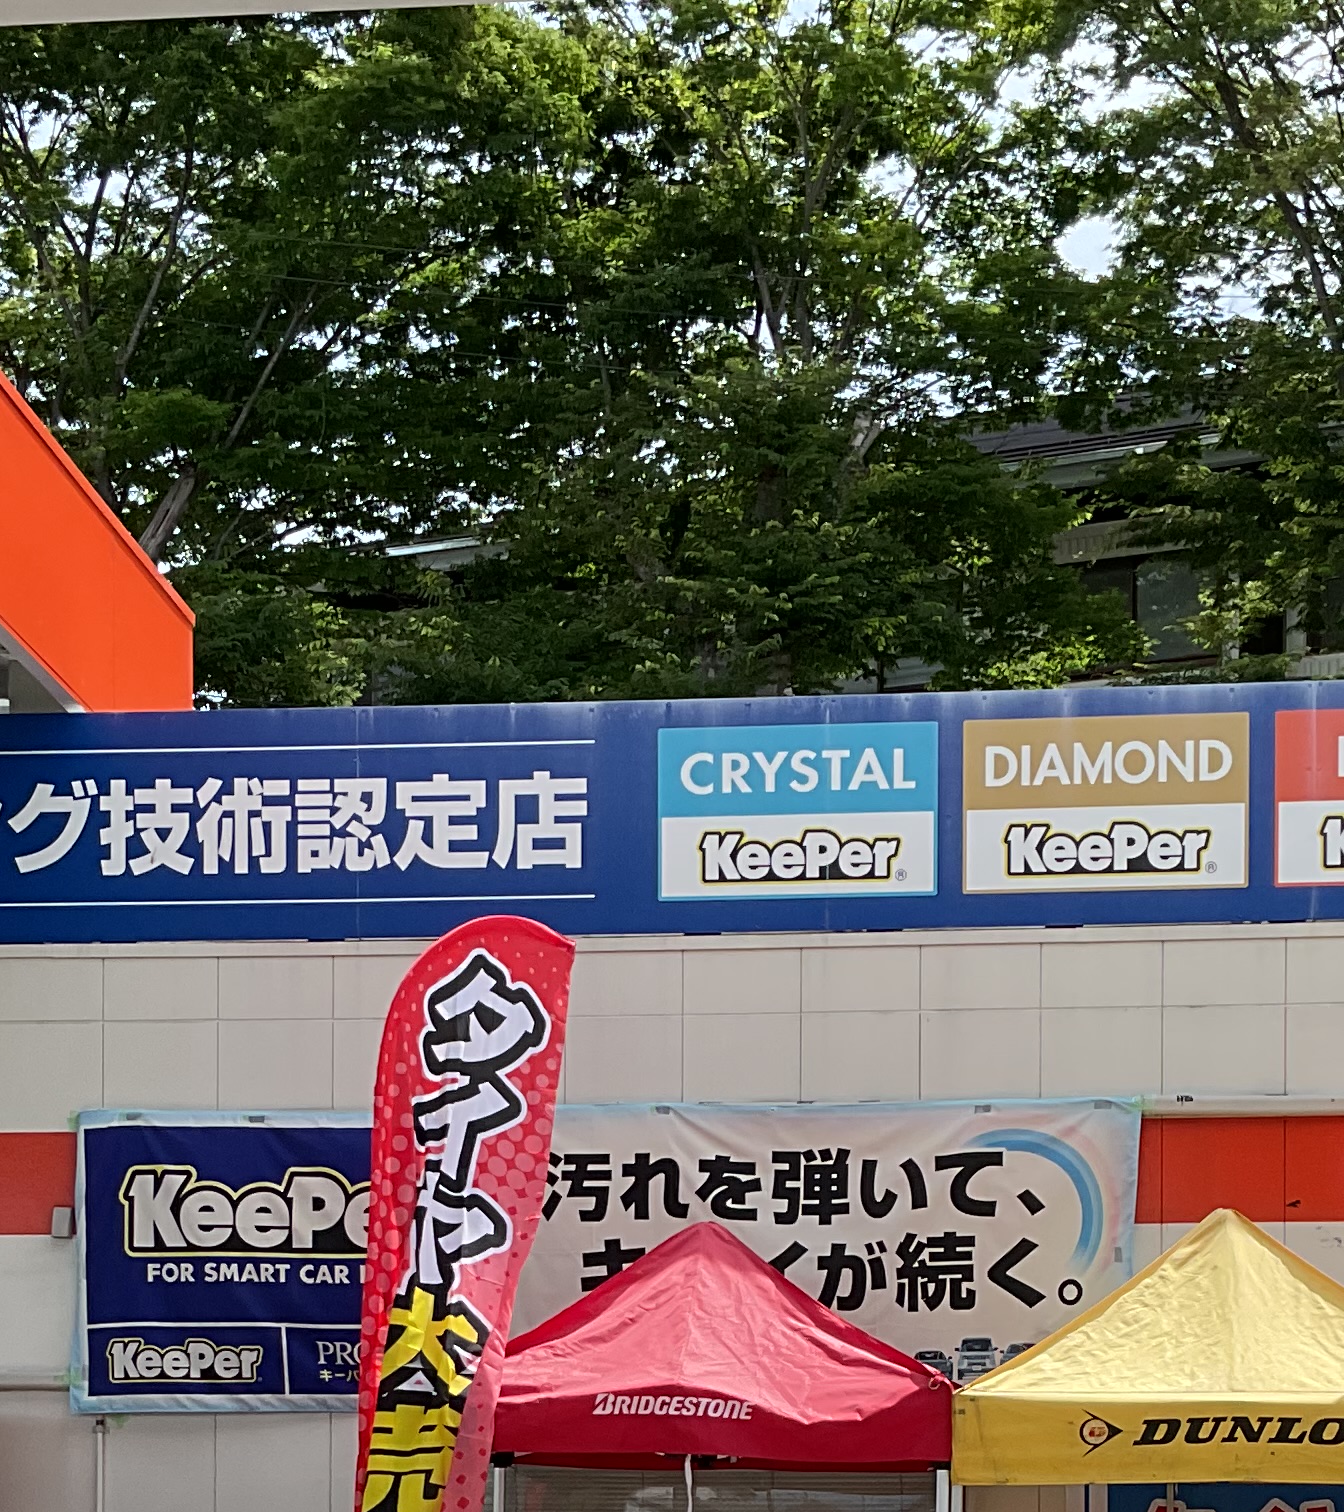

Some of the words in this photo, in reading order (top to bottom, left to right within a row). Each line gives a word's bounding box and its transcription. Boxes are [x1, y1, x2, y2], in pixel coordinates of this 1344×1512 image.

[680, 748, 916, 795] CRYSTAL
[984, 739, 1233, 787] DIAMOND
[700, 829, 900, 884] KeePer
[1005, 821, 1211, 878] KeePer
[123, 1167, 371, 1255] KeeP
[147, 1263, 195, 1283] FOR
[204, 1263, 290, 1283] SMART
[299, 1265, 350, 1284] CAR
[107, 1337, 263, 1383] KeePer
[592, 1392, 755, 1420] BRIDGESTONE
